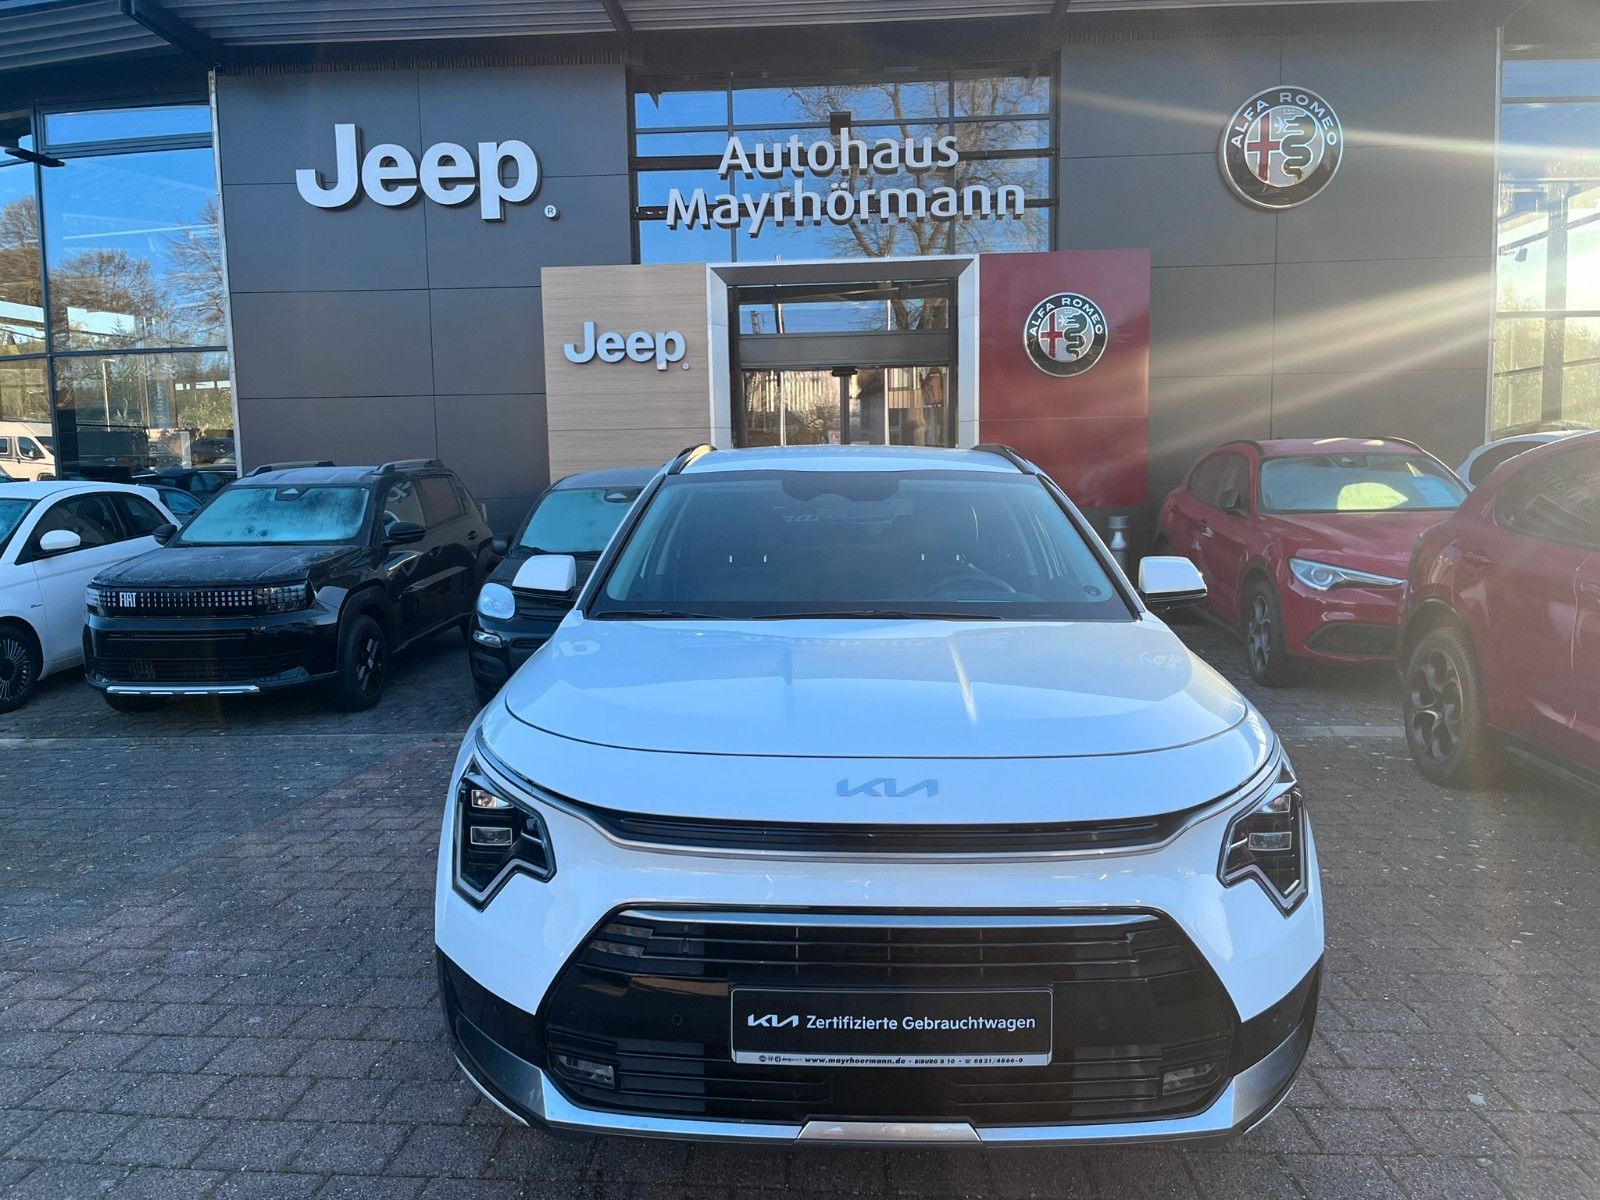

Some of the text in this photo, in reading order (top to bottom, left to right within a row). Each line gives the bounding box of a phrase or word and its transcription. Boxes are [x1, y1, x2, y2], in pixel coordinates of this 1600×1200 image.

[1231, 91, 1337, 149] ALFA ROMEO
[295, 122, 541, 222] Jeep
[717, 127, 960, 181] Autohaus
[665, 179, 1026, 239] Mayrhörmann
[1029, 297, 1104, 337] ALFA ROMEO
[563, 320, 687, 371] Jeep
[119, 591, 137, 608] FIAT
[836, 777, 939, 798] KIA
[747, 1013, 1036, 1032] KIA Zertifizierte Gebrauchtwagen
[804, 1056, 906, 1065] www.mayrhoermann.de
